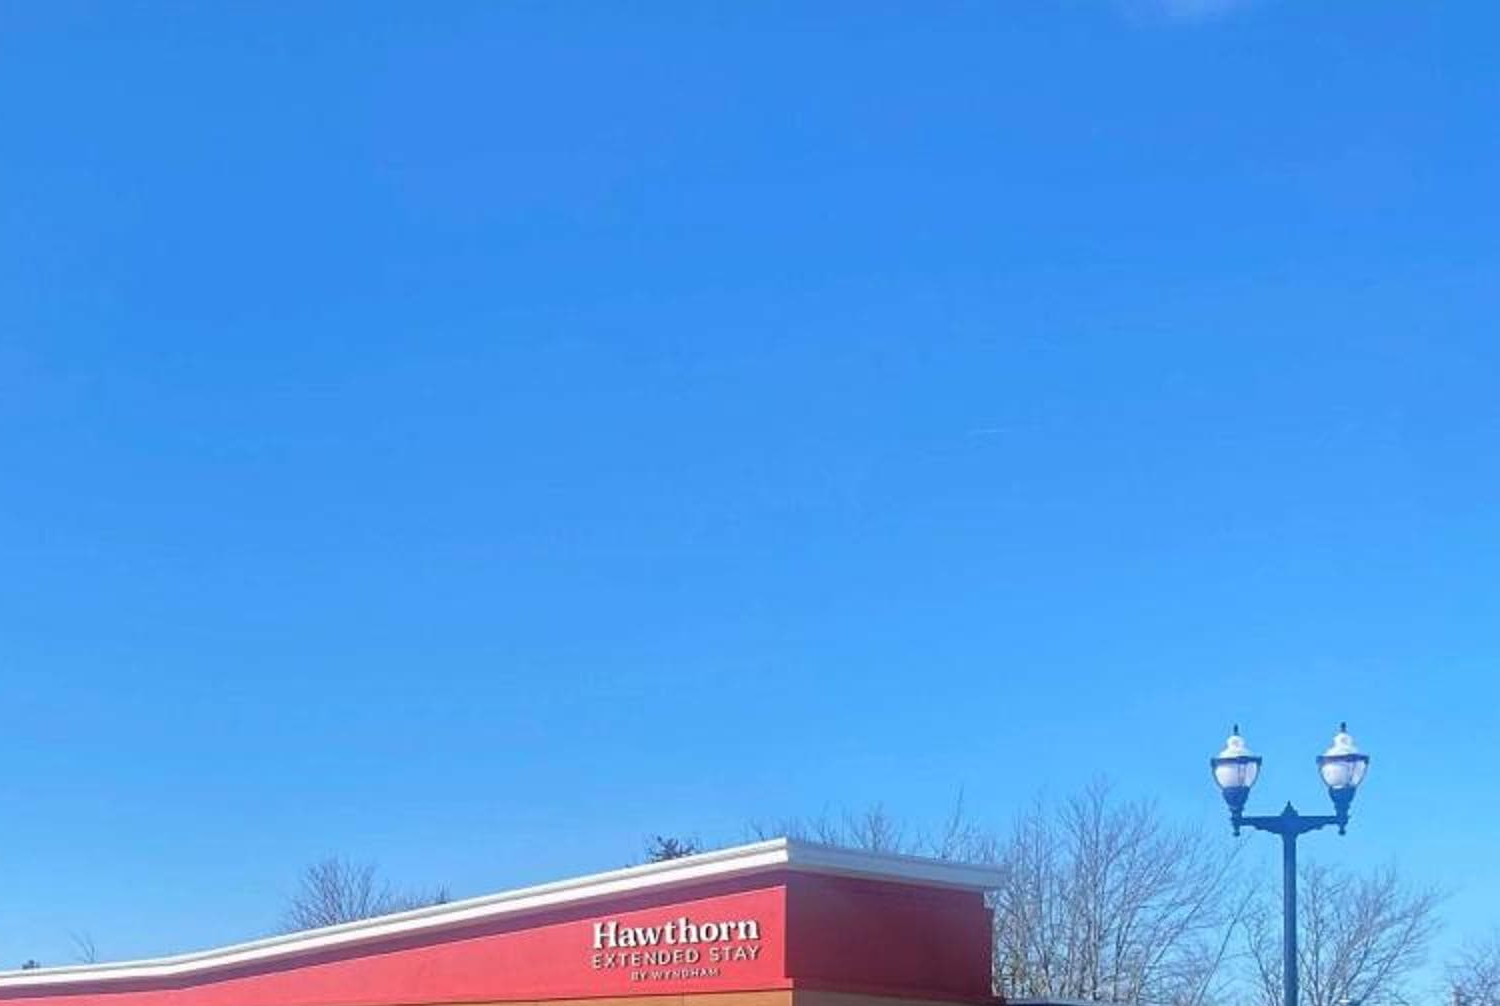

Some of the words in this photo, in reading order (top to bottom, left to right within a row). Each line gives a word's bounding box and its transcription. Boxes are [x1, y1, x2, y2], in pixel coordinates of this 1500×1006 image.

[592, 917, 760, 950] Hawthorn
[591, 948, 700, 969] EXTENDED
[709, 945, 759, 962] STAY
[650, 967, 719, 981] WYNDHAM
